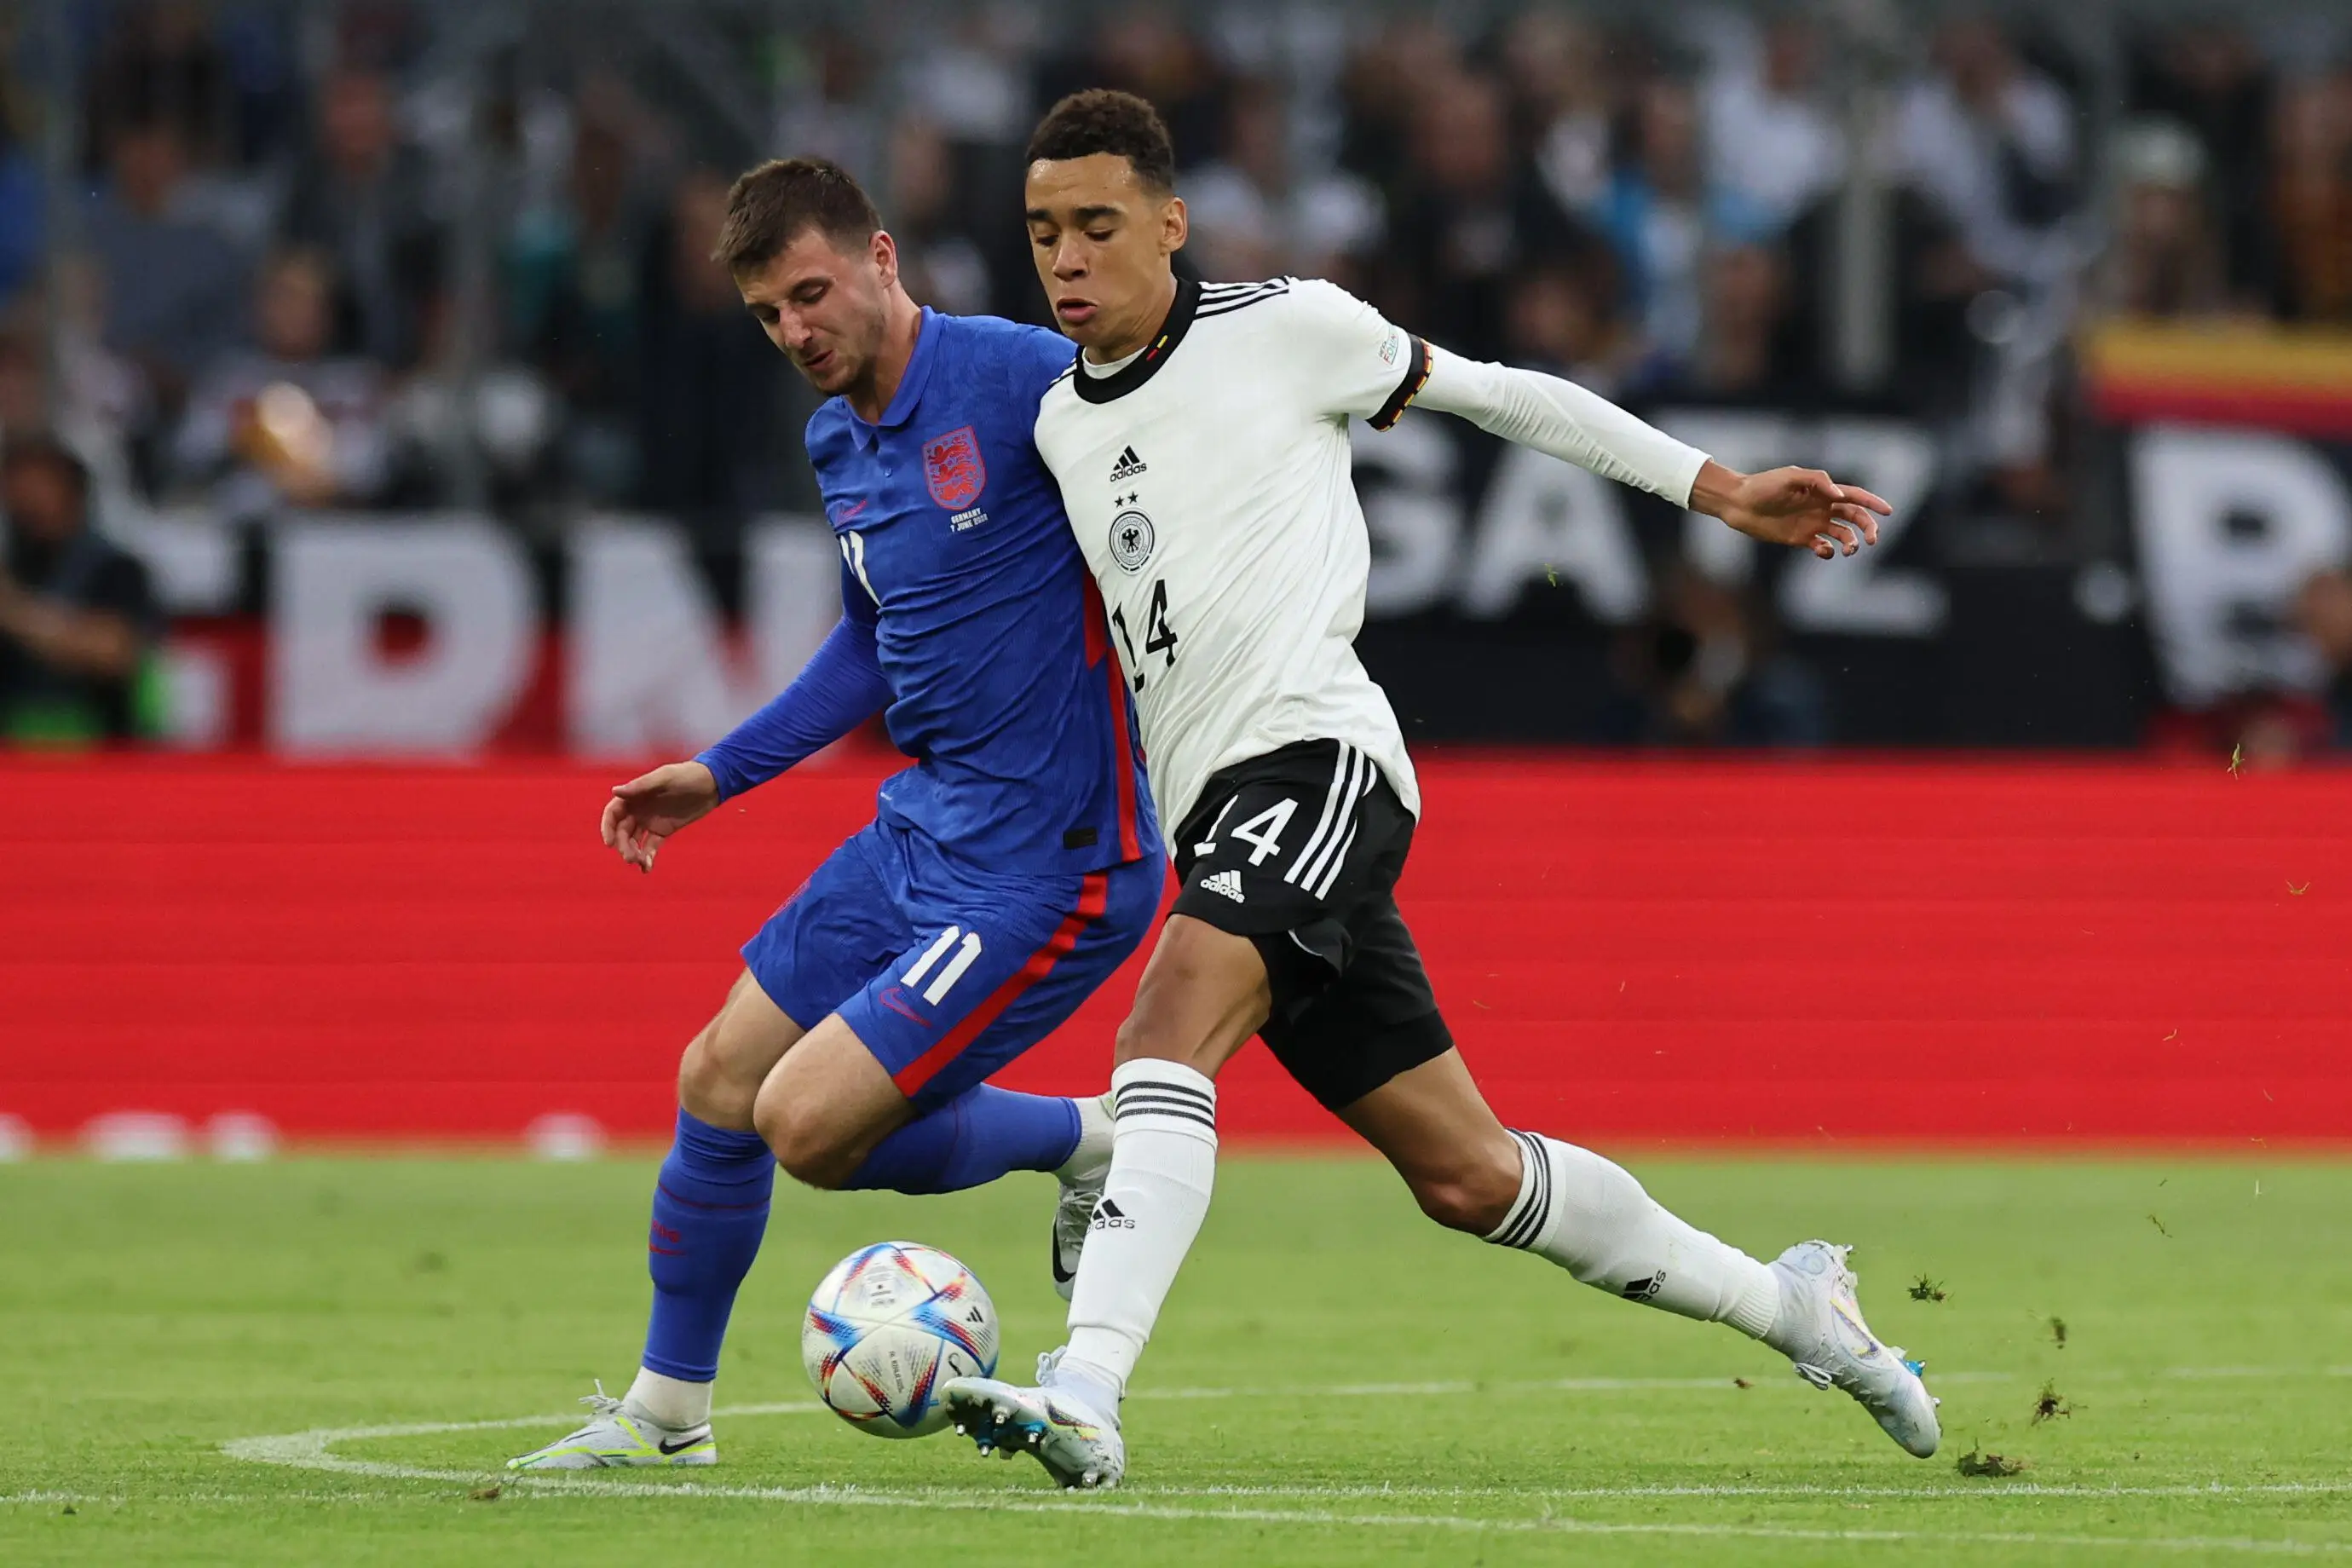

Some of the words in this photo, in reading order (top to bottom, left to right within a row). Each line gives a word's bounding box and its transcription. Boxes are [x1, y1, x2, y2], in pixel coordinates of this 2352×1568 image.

[1110, 463, 1147, 481] adidas
[951, 508, 981, 524] GERMANY
[957, 519, 973, 531] JUNE
[1111, 579, 1179, 694] 14
[1200, 878, 1245, 903] adidas
[900, 925, 983, 1007] 11
